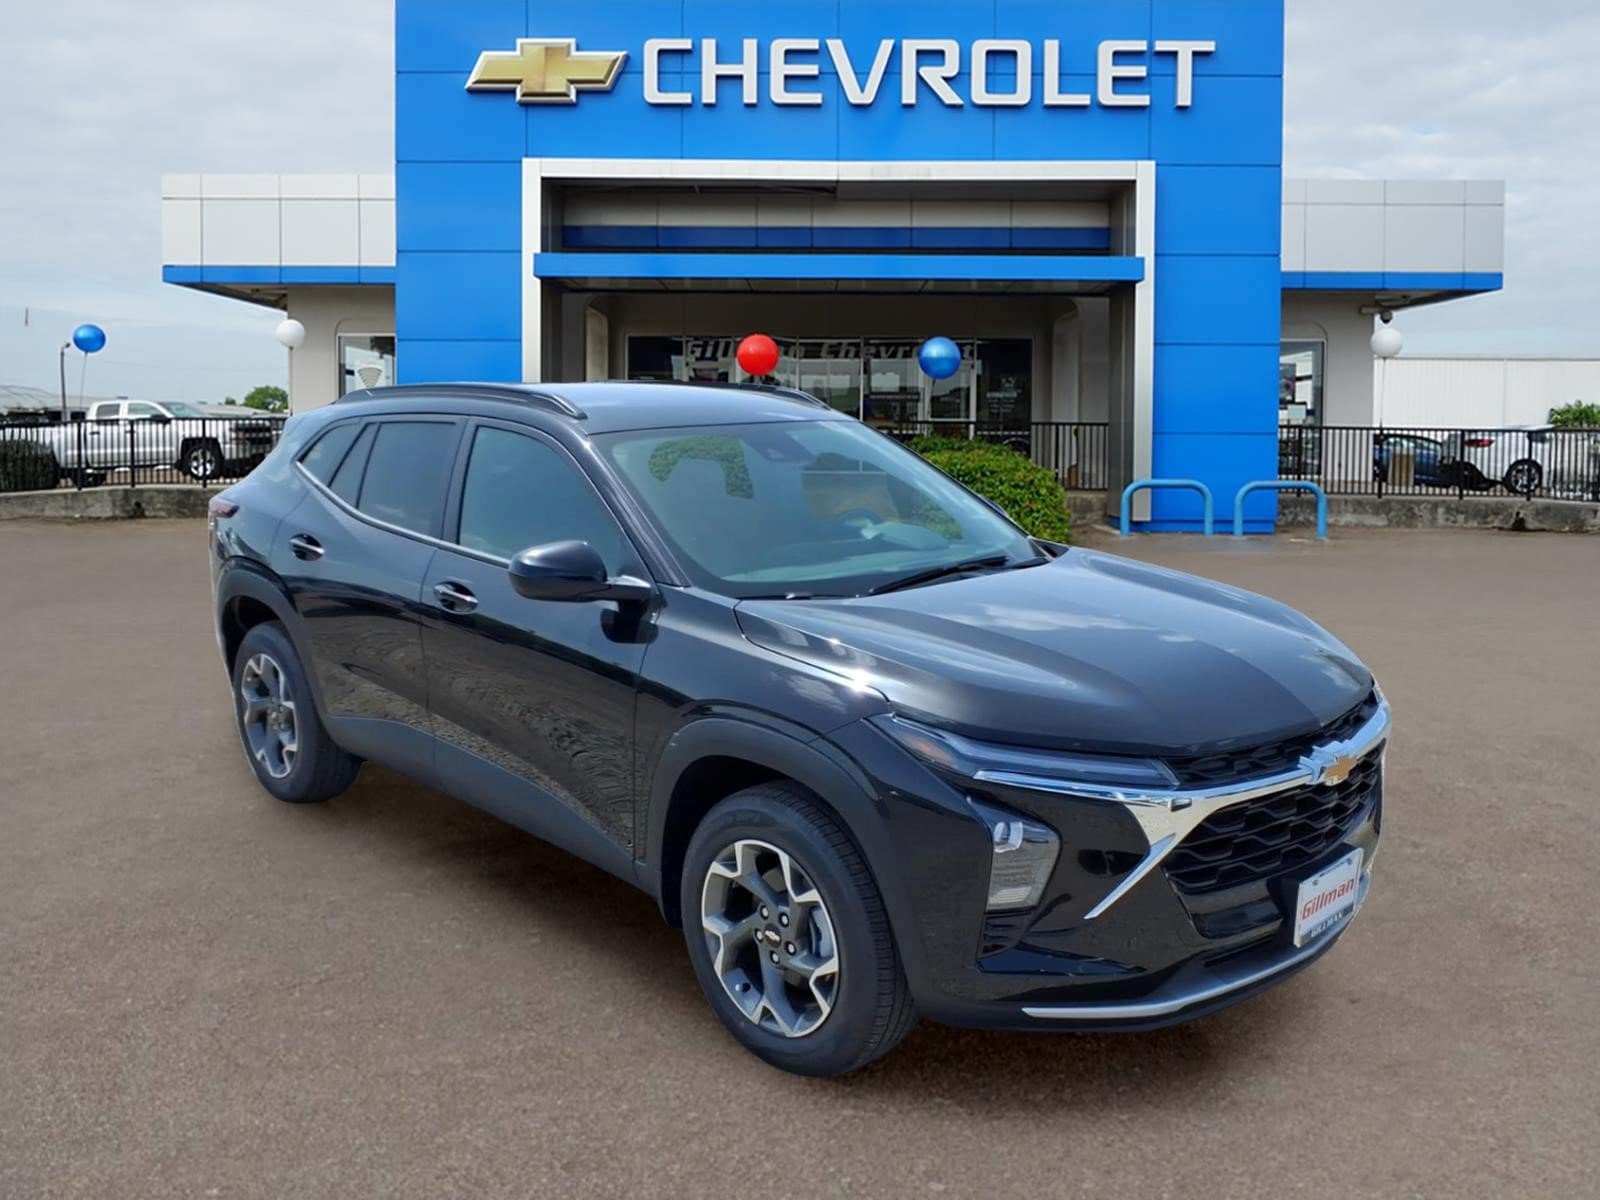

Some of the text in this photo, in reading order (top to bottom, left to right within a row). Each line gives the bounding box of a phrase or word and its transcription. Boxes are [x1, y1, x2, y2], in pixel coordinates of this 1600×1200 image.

[643, 38, 1216, 107] CHEVROLET
[686, 338, 974, 359] Gilln Chevrt
[1302, 878, 1355, 919] Gillman
